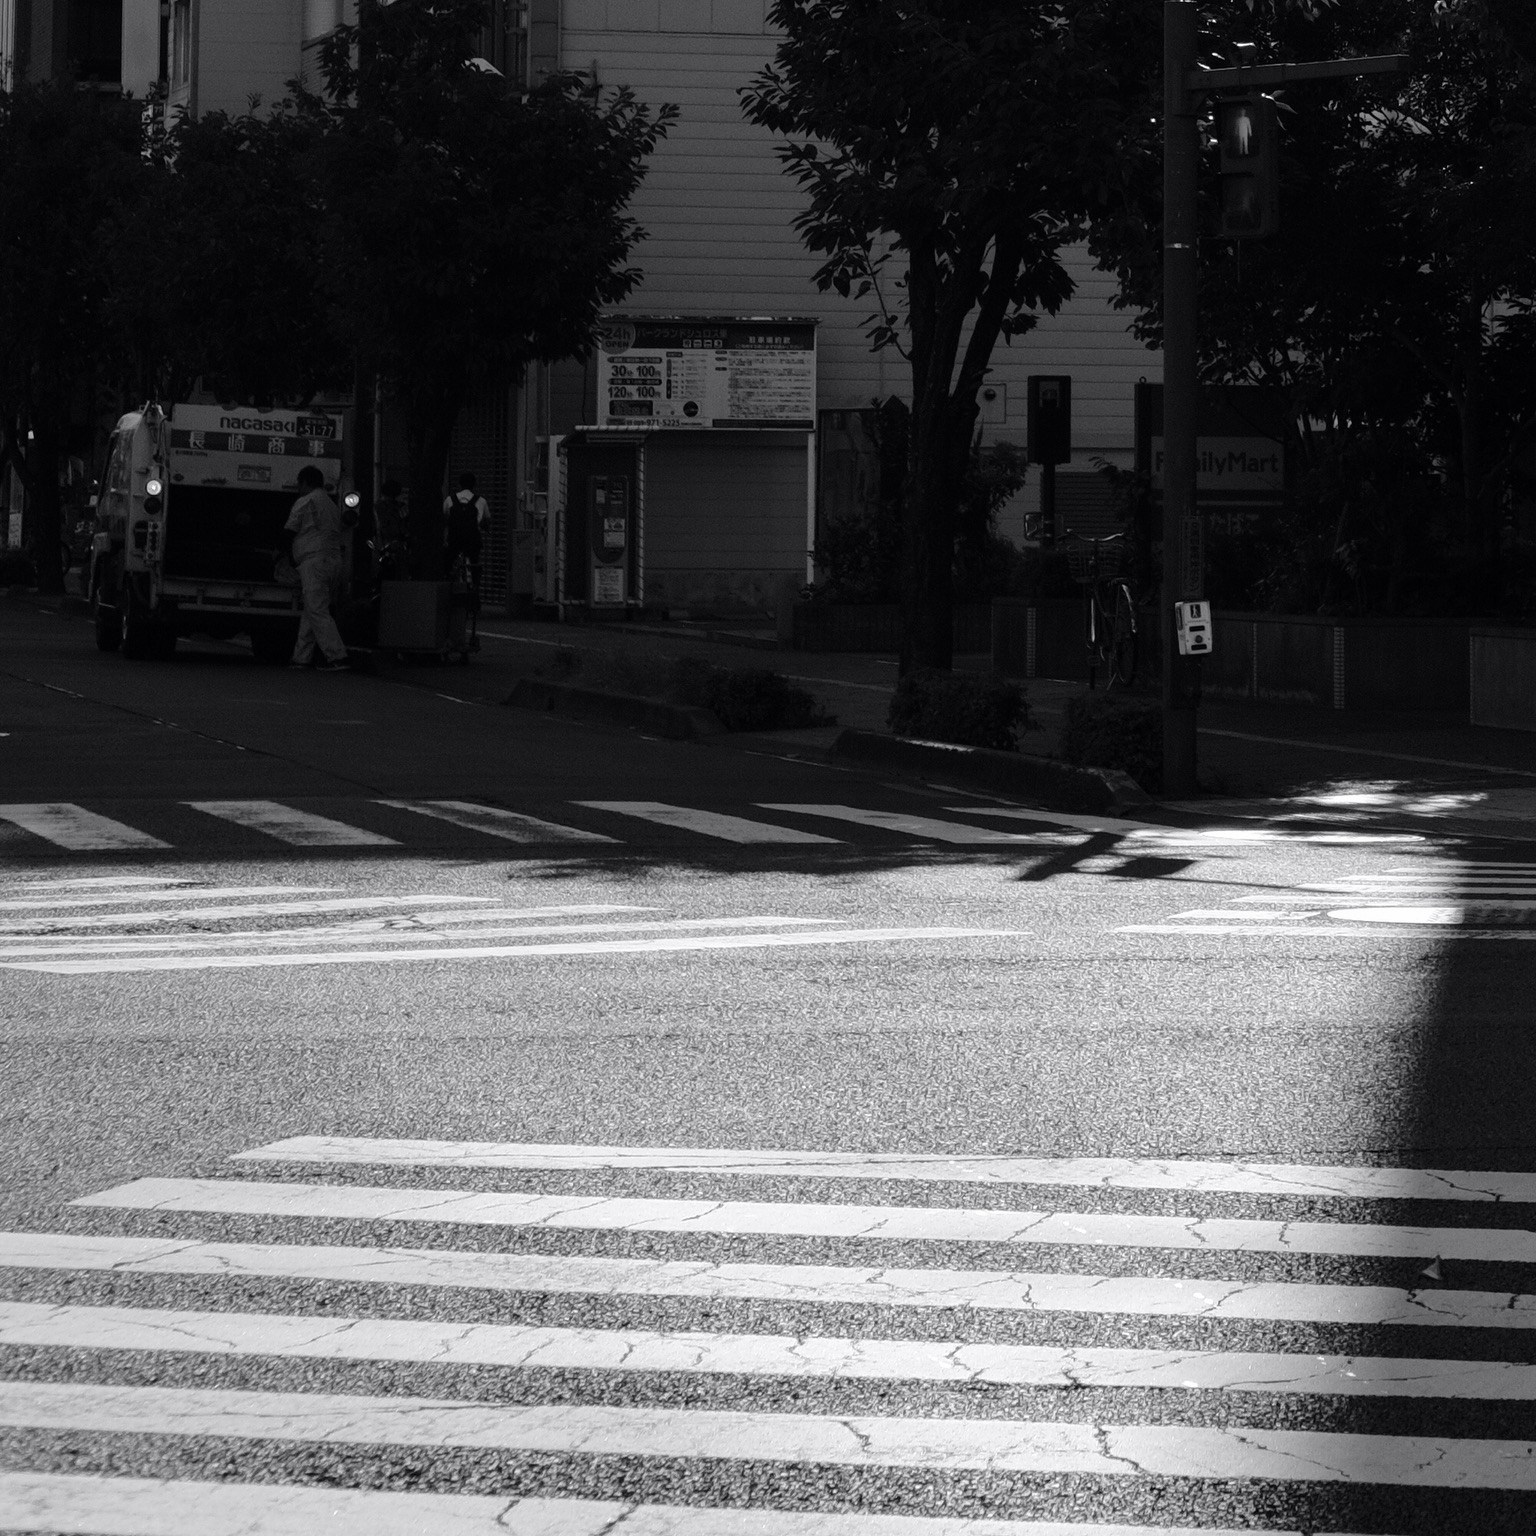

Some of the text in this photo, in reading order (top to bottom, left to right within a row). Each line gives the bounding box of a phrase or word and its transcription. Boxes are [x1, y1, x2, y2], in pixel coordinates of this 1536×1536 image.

[189, 431, 326, 457] 長崎商事
[1155, 450, 1280, 476] FilyMart
